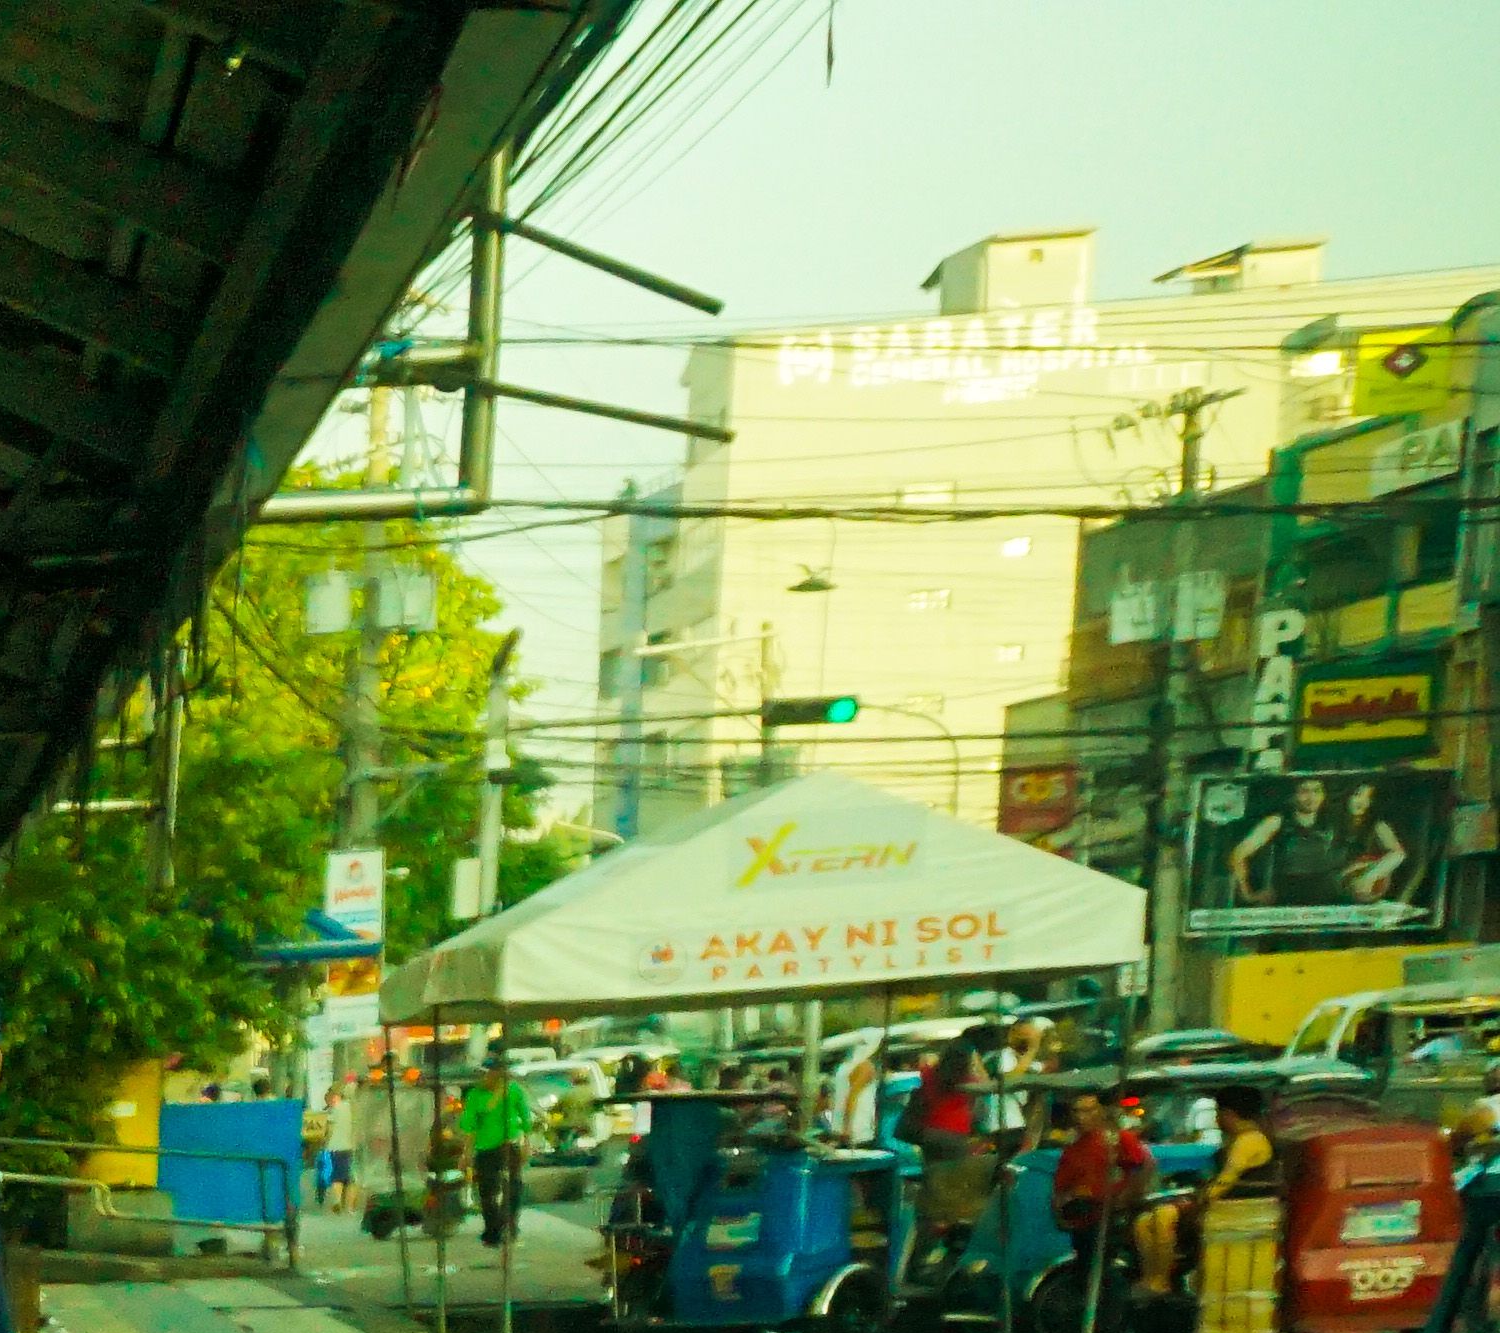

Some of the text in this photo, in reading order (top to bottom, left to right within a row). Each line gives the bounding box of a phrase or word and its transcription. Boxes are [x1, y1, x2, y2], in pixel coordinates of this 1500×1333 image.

[850, 354, 991, 386] GENERAL
[701, 911, 1009, 961] AKAY NI SOL
[711, 944, 998, 981] PARTYLIST
